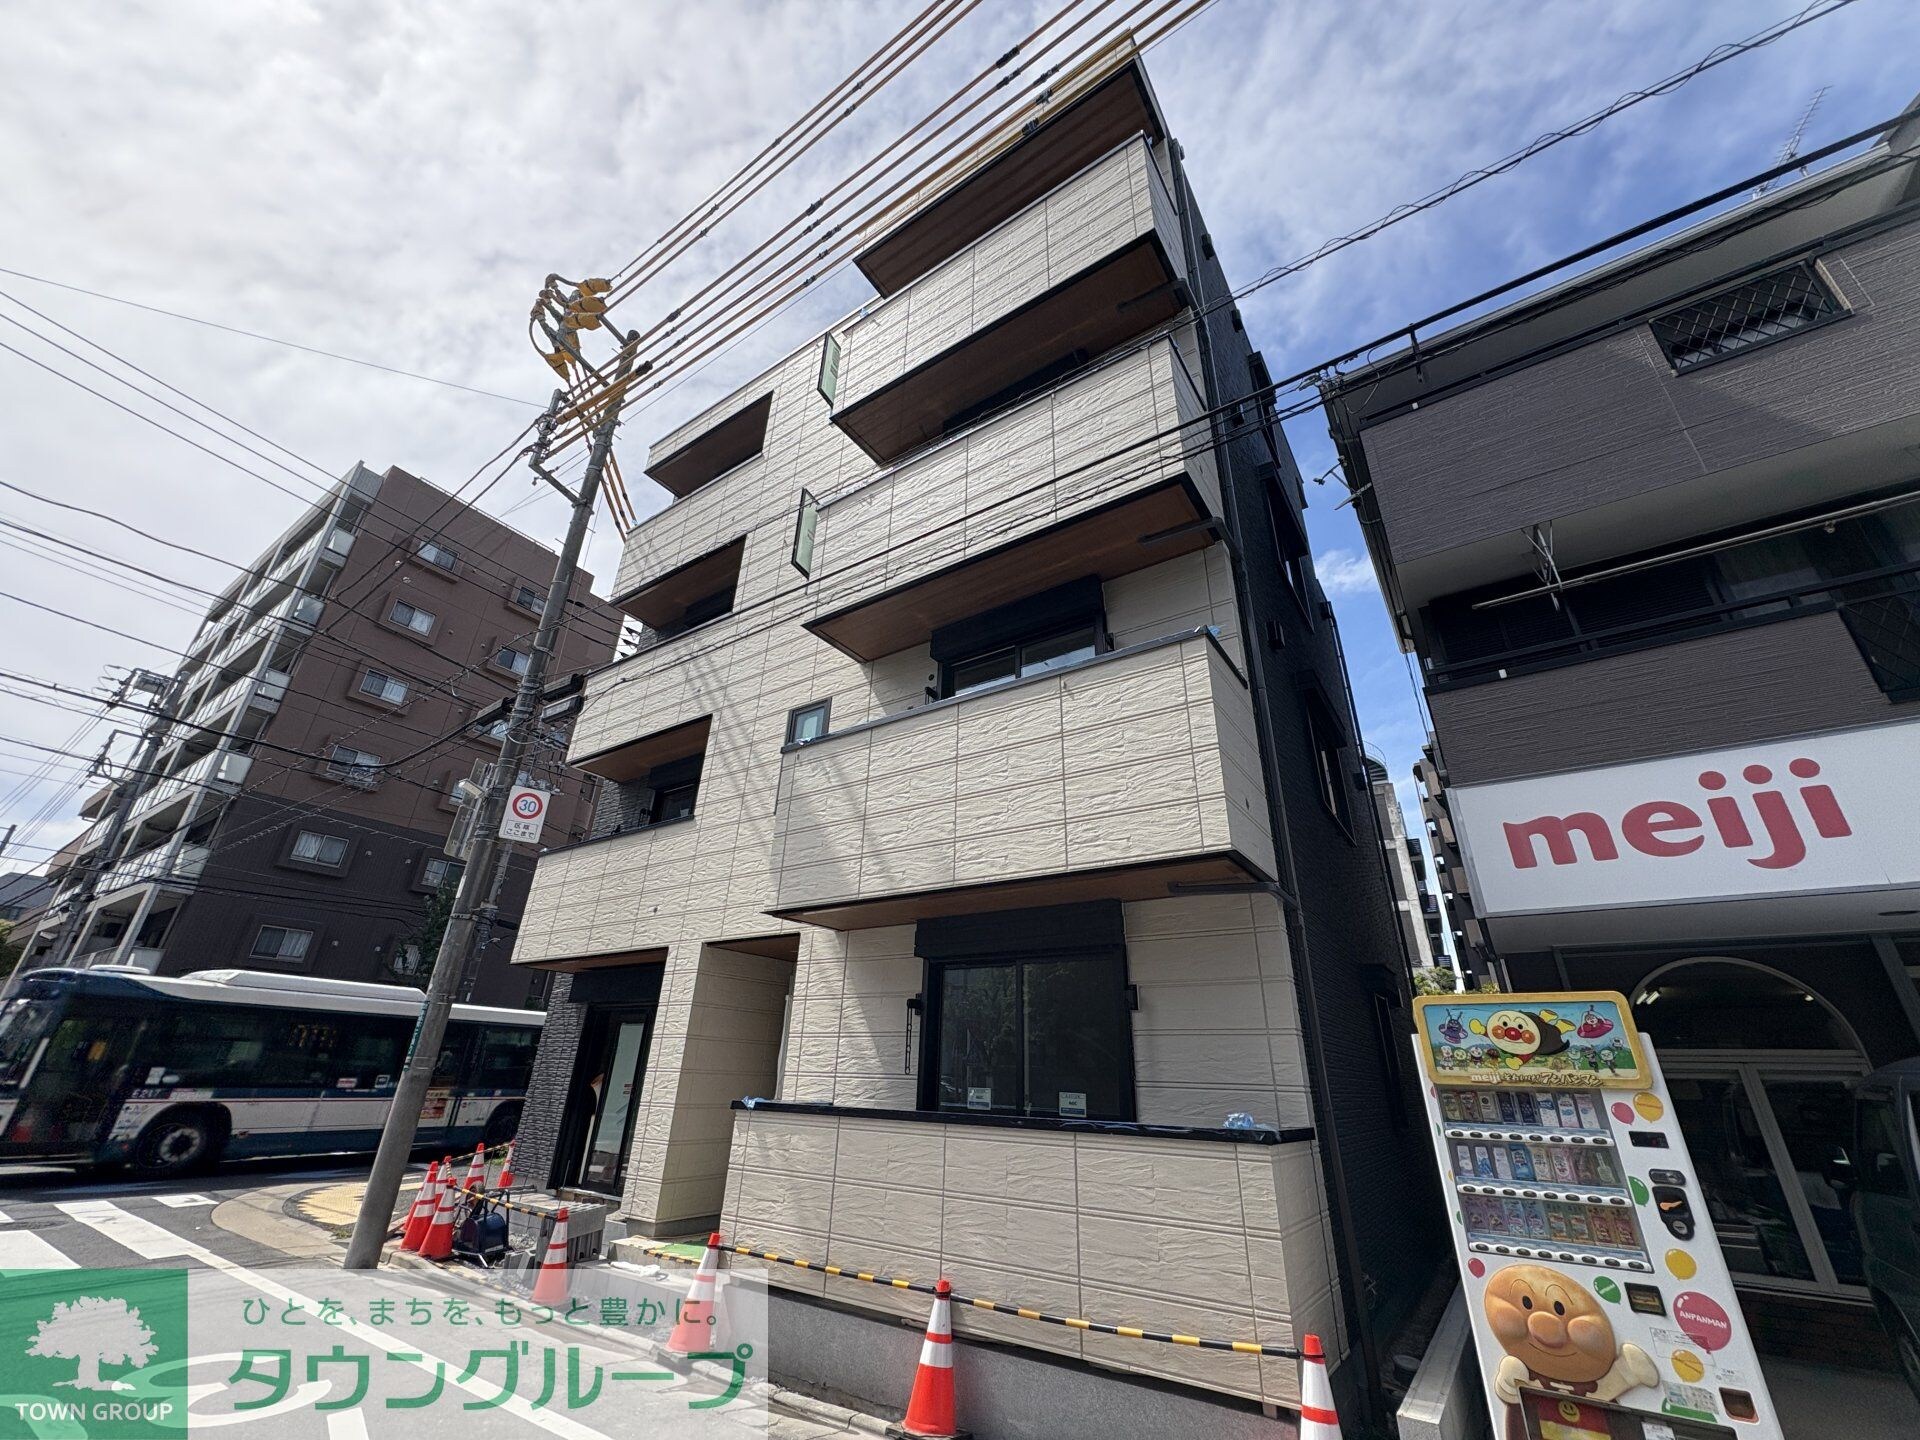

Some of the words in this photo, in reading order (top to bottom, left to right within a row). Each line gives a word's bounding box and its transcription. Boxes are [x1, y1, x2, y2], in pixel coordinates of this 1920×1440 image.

[519, 799, 537, 812] 30
[1503, 758, 1852, 869] meiji
[506, 829, 535, 838] ここまで
[1471, 1072, 1501, 1084] meiji
[1679, 1310, 1727, 1329] ANPANMAN
